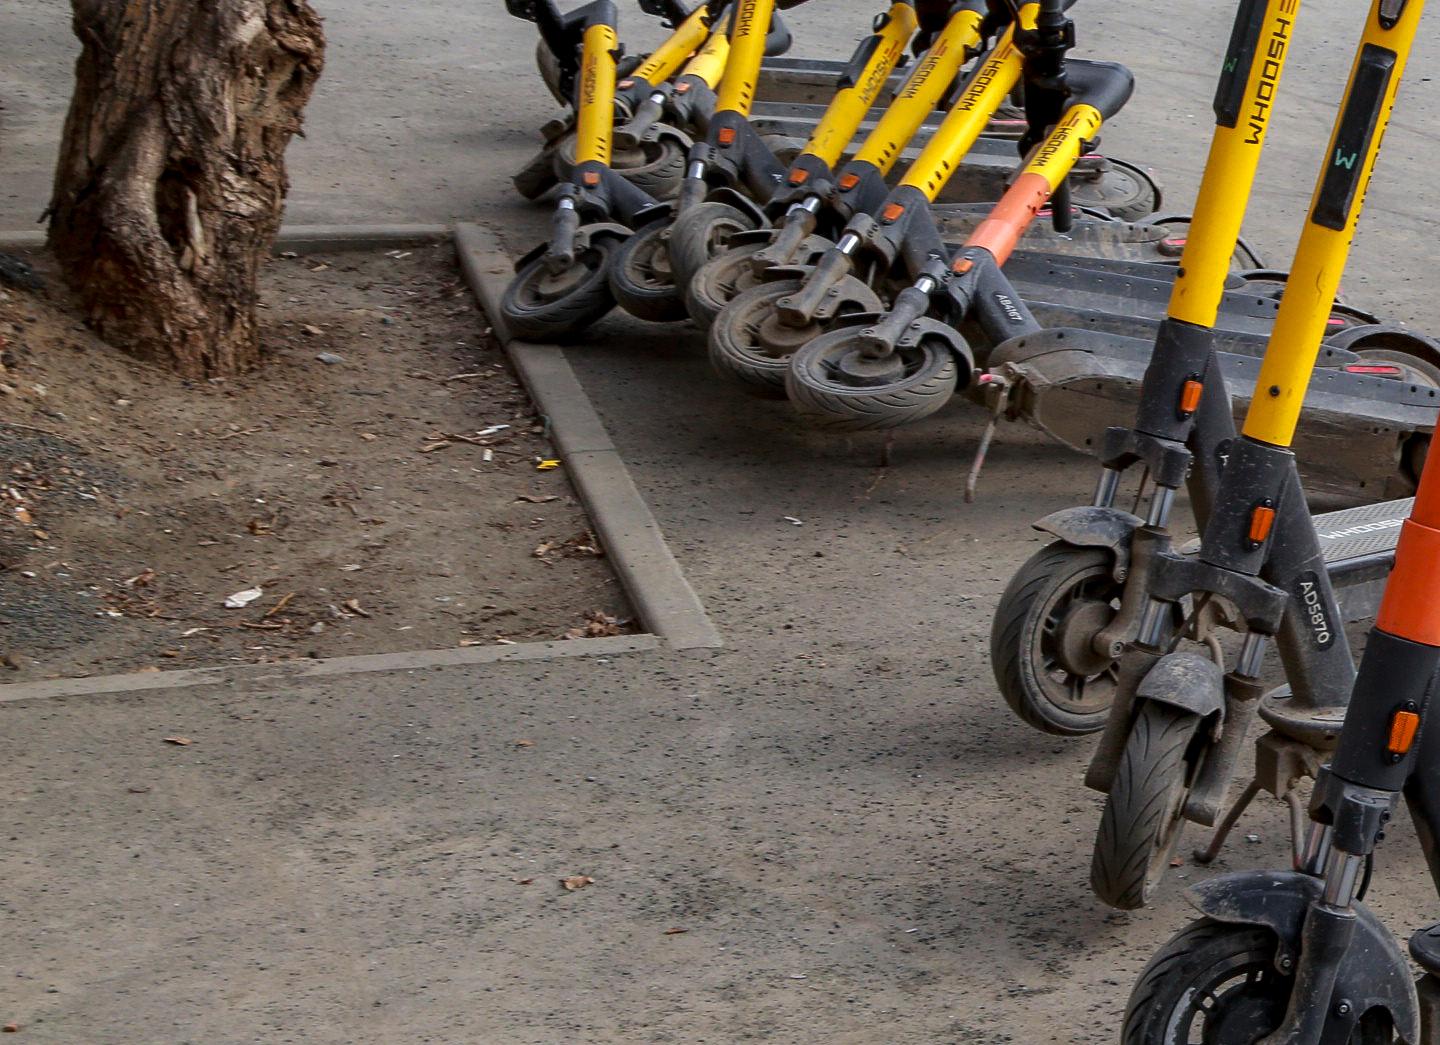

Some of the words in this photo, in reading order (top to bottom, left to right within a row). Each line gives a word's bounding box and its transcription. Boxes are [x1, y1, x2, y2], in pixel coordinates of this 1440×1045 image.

[737, 0, 756, 37] WHOO
[901, 55, 940, 99] WHOOSH
[957, 59, 1004, 112] WHOOSH
[1244, 17, 1290, 145] WHOOSH
[1031, 127, 1073, 167] WHOOSH
[1334, 148, 1357, 169] W
[995, 294, 1024, 321] AB4167
[1300, 582, 1330, 644] AD5870
